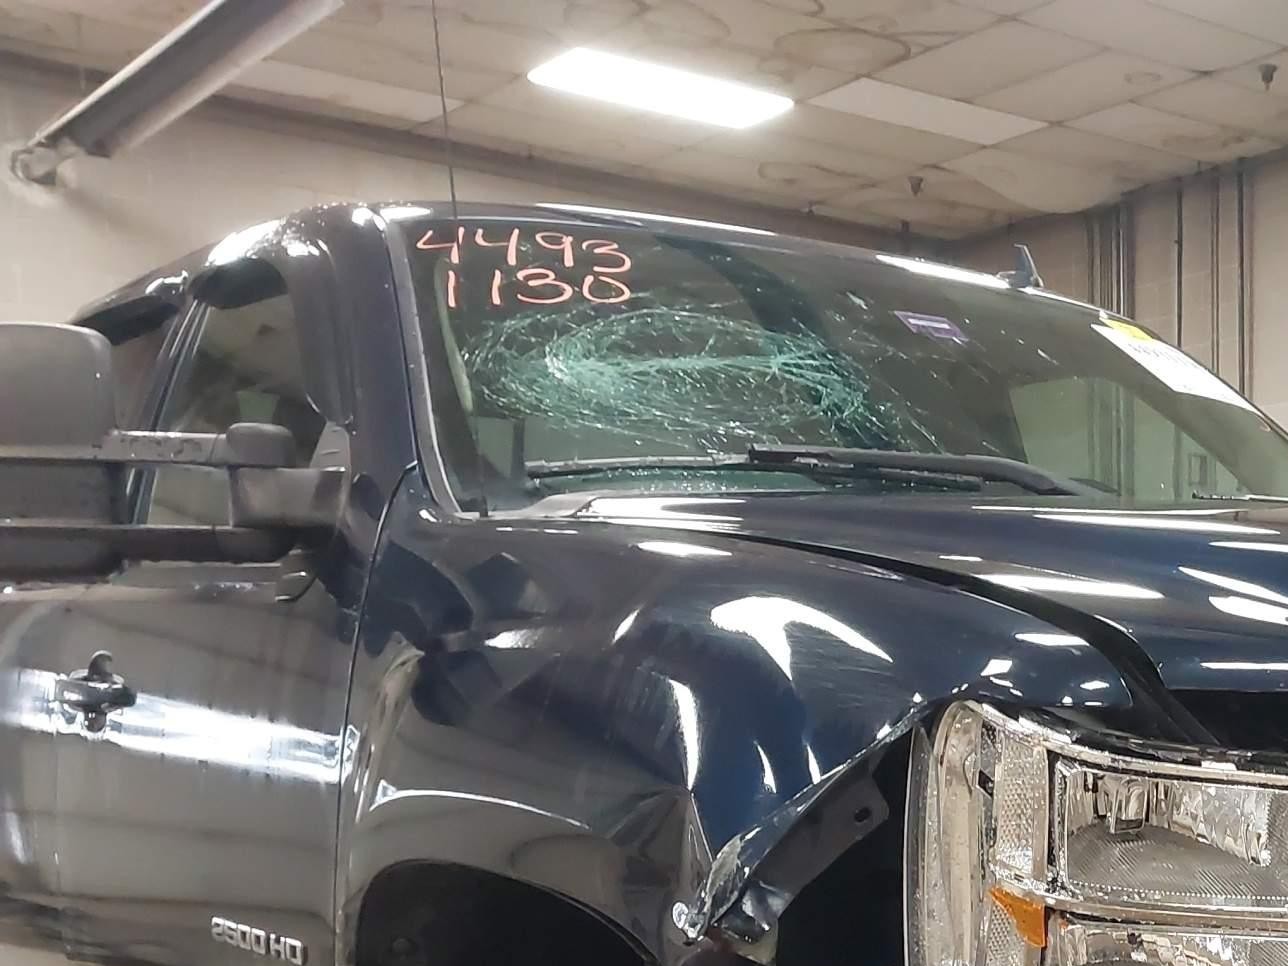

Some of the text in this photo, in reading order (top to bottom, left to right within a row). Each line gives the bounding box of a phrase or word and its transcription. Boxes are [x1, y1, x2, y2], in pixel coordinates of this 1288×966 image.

[416, 226, 632, 273] 4493
[447, 267, 631, 308] 1130
[211, 916, 304, 966] 2500 HD
